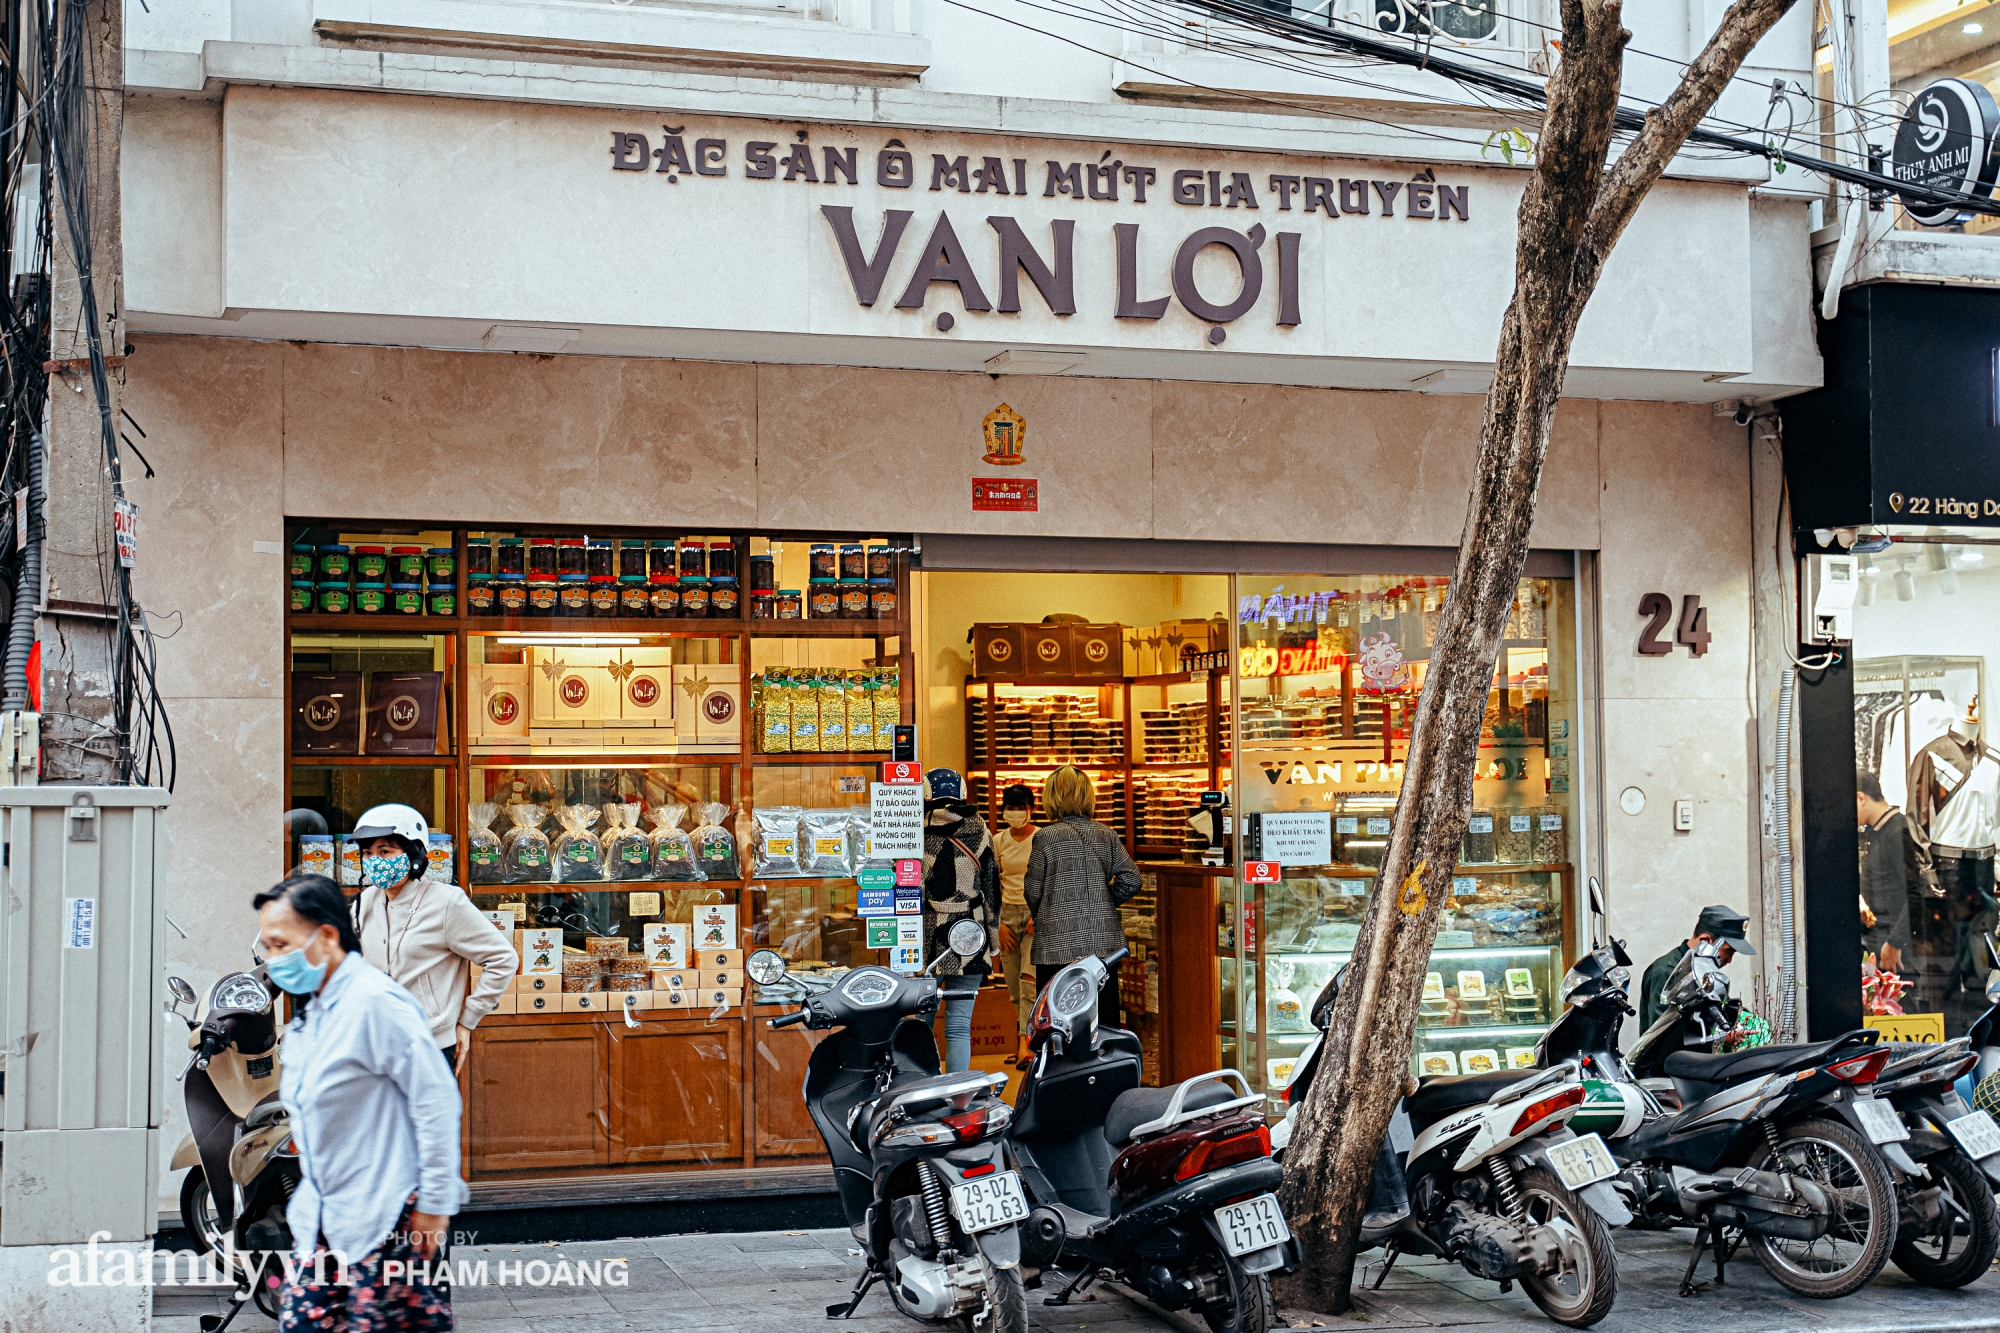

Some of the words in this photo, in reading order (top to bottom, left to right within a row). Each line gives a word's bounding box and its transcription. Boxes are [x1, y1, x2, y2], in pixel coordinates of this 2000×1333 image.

[1928, 151, 1953, 172] ANH
[1955, 146, 1969, 165] MI
[610, 125, 727, 184] ĐẶC
[745, 130, 858, 185] SẢN
[877, 138, 914, 188] Ô
[930, 155, 1027, 197] MAI
[1044, 149, 1157, 203] MỨT
[1174, 169, 1260, 210] GIA
[1270, 168, 1471, 222] TRUYỀN
[820, 203, 1077, 333] VẠN
[1112, 222, 1304, 345] LỢI
[1908, 497, 1930, 514] 22
[1935, 497, 1979, 519] Hàng
[1638, 592, 1712, 657] 24
[1259, 760, 1343, 784] VAN
[876, 800, 884, 808] TỰ
[885, 798, 900, 807] BẢO
[901, 797, 920, 807] QUẢN
[878, 787, 892, 796] QUÝ
[893, 787, 916, 796] KHÁCH
[873, 819, 886, 828] MẤT
[888, 819, 902, 828] NHÀ
[902, 819, 921, 828] HÀNG
[883, 809, 893, 817] VÀ
[894, 809, 912, 817] HÀNH
[913, 809, 921, 817] LÝ
[874, 841, 896, 849] TRÁCH
[896, 841, 917, 850] NHIỆM
[876, 830, 899, 839] KHÔNG
[900, 831, 916, 840] CHỊU
[868, 898, 884, 906] pay
[900, 951, 920, 961] JCB
[1223, 1123, 1254, 1136] HONDA
[1567, 1156, 1609, 1182] 1971
[962, 1177, 1011, 1207] 29-D2
[963, 1197, 1025, 1229] 342.63
[1225, 1200, 1273, 1230] 29-T2
[1233, 1220, 1279, 1250] 4710
